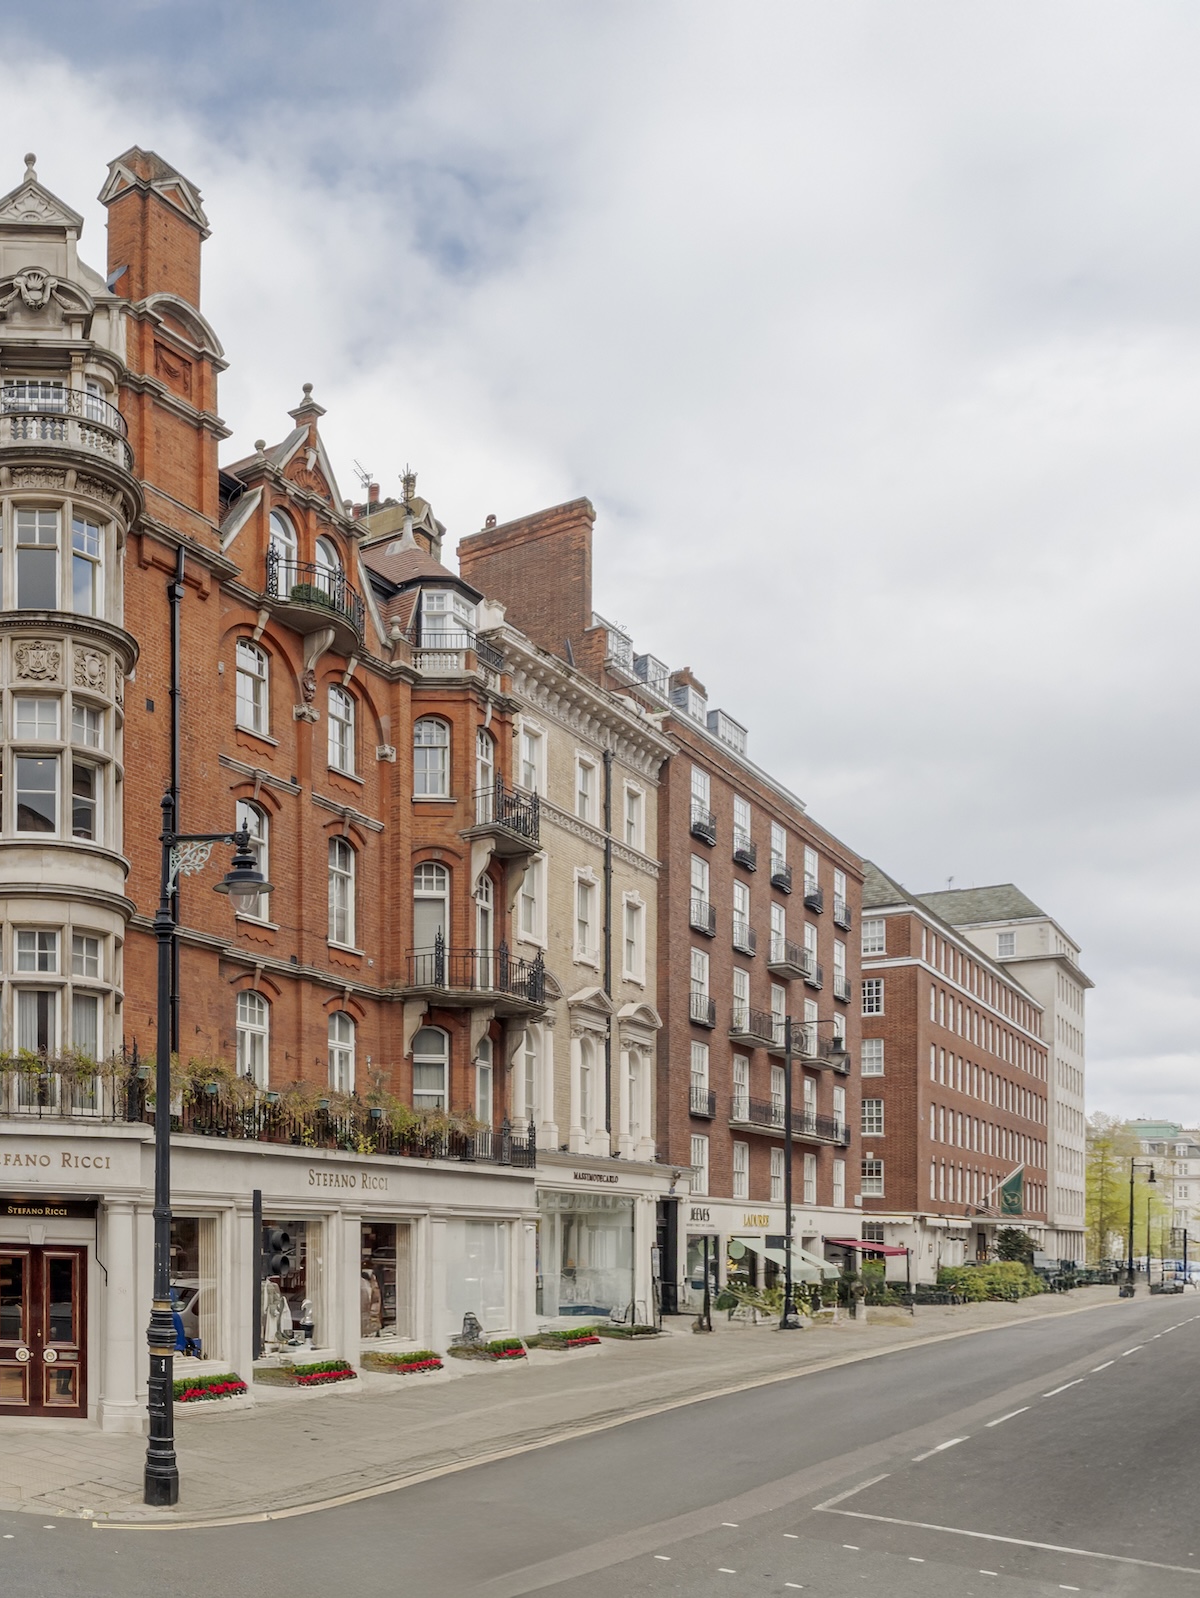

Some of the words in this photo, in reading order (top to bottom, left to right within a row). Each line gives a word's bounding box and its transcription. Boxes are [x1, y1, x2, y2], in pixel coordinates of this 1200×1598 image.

[61, 1152, 111, 1170] RICCI
[308, 1168, 357, 1189] STEFANO
[361, 1172, 389, 1191] RICCI
[7, 1206, 44, 1215] STEFANO
[44, 1206, 68, 1216] RICCI
[689, 1207, 711, 1222] JEEVES
